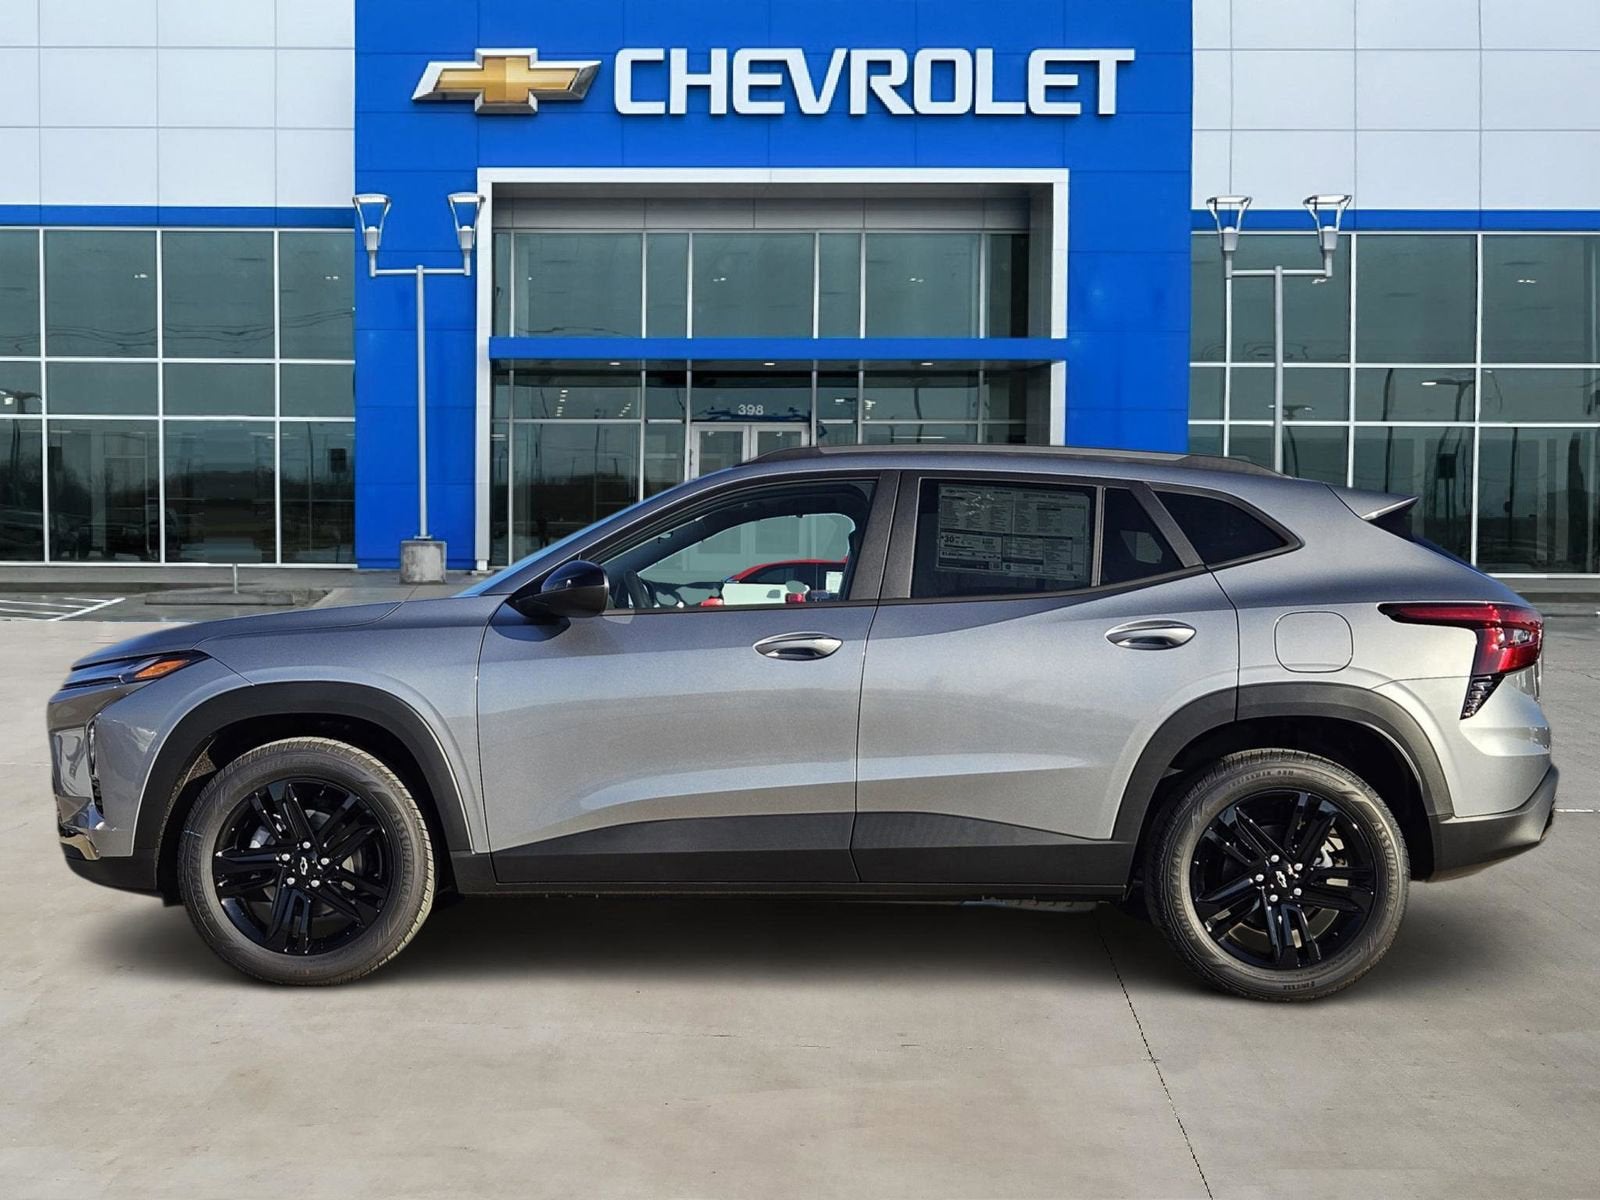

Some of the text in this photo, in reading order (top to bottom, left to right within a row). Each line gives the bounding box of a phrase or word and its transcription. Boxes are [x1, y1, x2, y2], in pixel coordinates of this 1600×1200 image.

[614, 48, 1135, 116] CHEVROLET
[737, 404, 765, 416] 398
[1372, 820, 1397, 915] ASSURANCE
